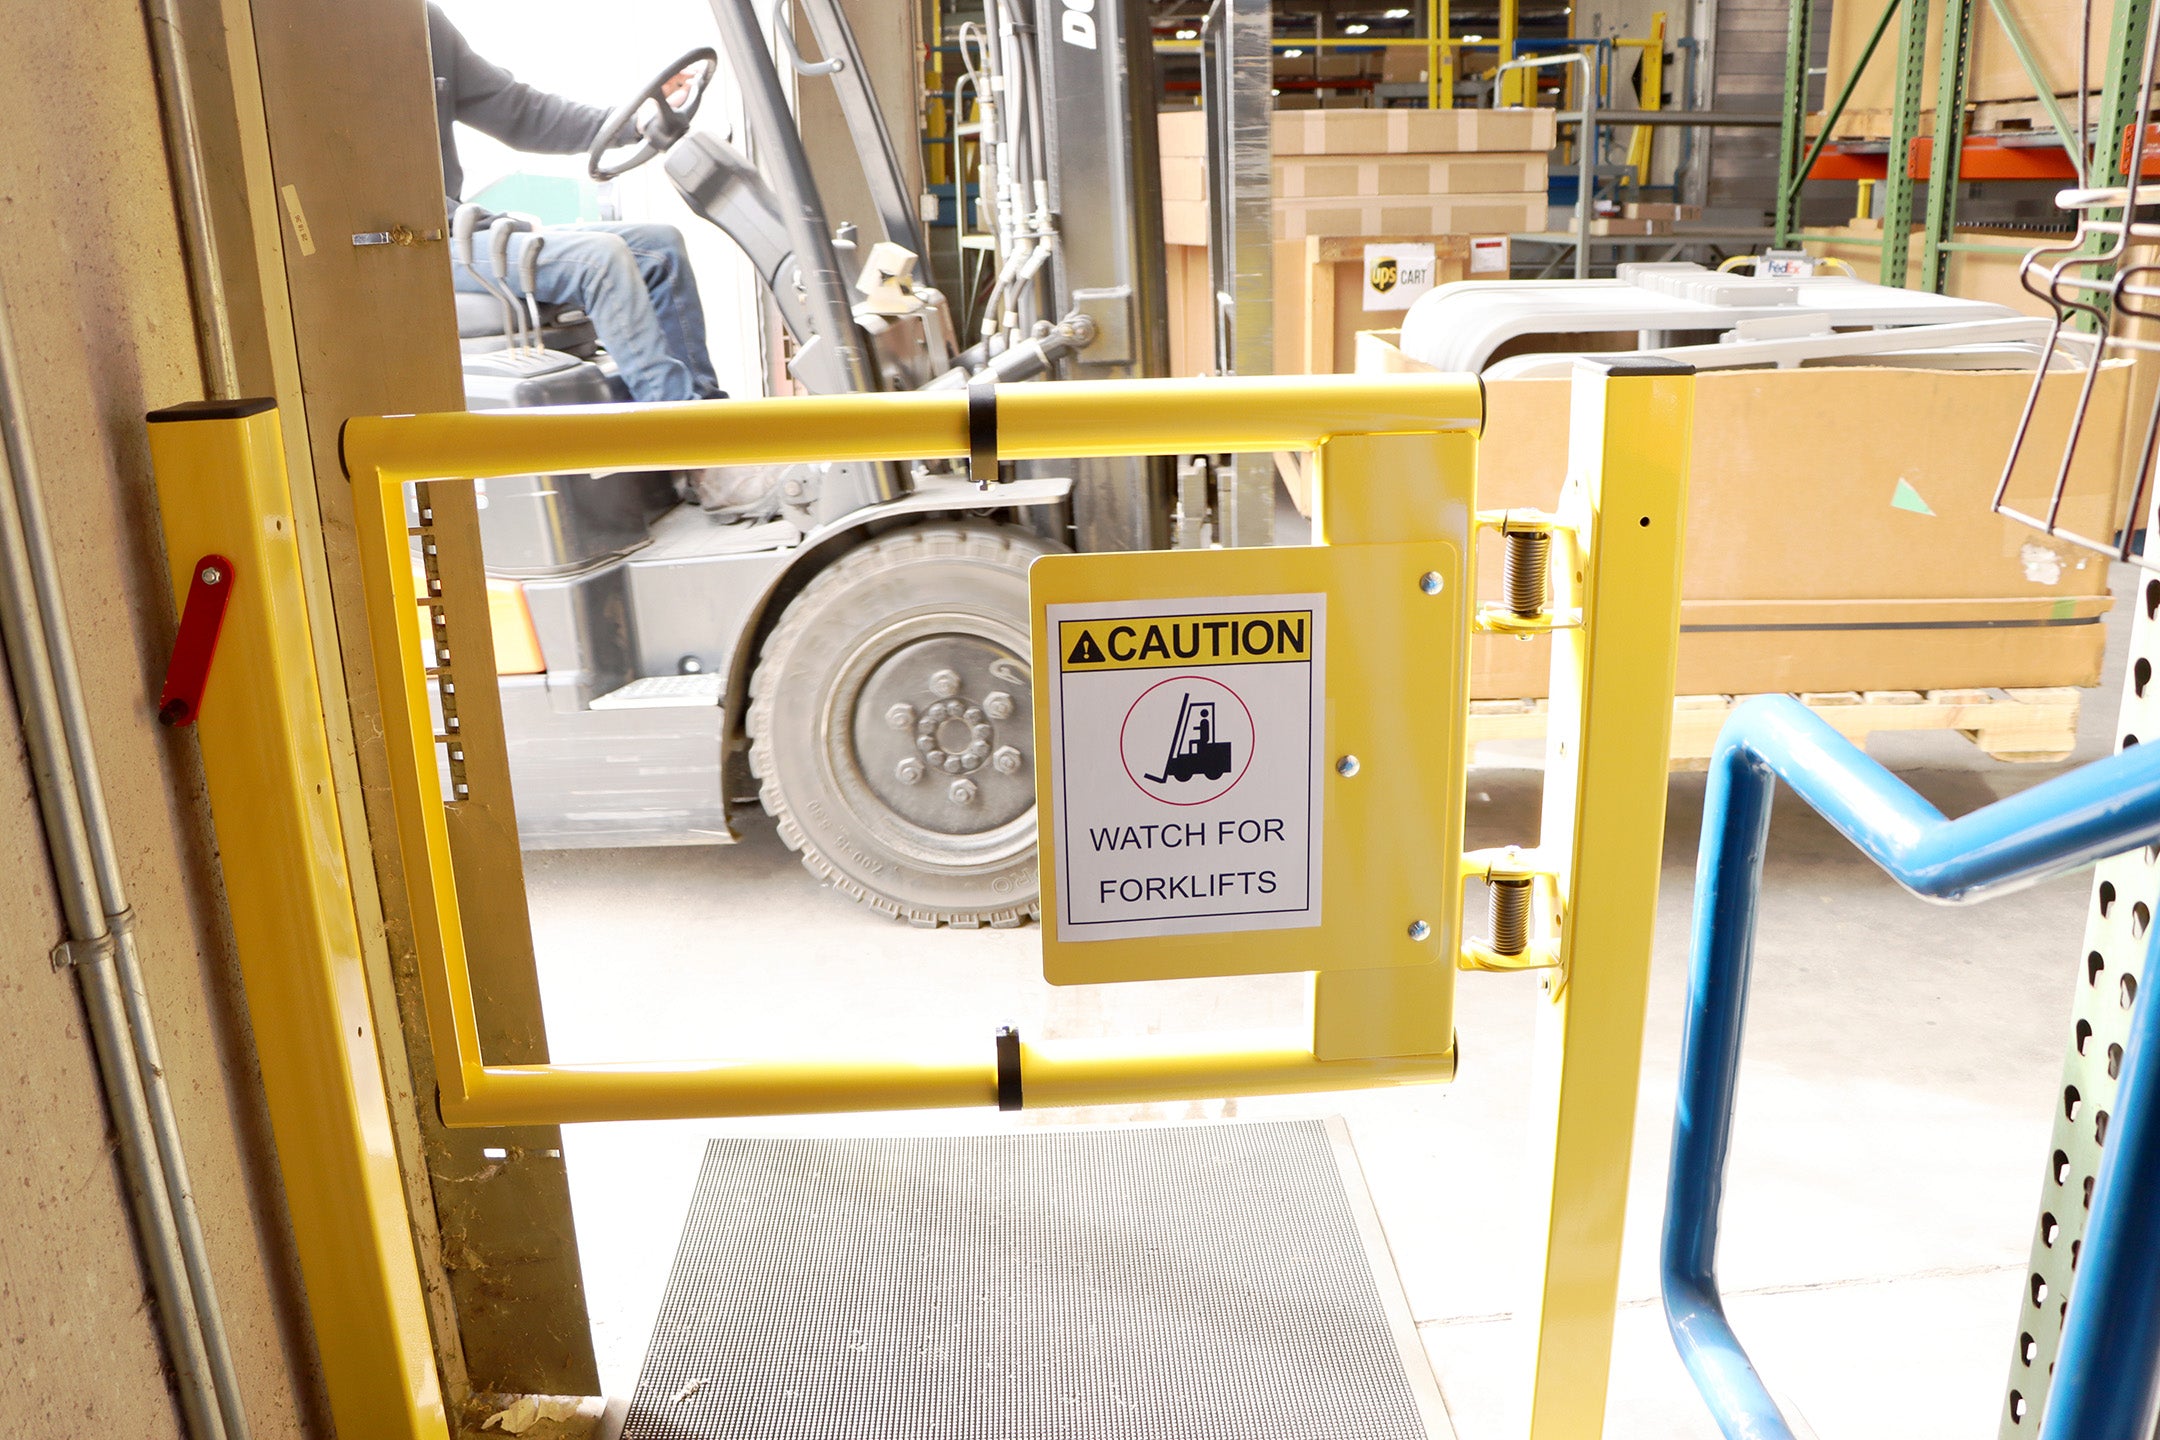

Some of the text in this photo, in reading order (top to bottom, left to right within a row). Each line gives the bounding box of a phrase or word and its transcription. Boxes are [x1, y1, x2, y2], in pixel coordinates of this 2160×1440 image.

[1372, 266, 1427, 290] ups CART
[1768, 260, 1800, 275] FedEx
[1107, 618, 1305, 662] CAUTION
[1089, 818, 1286, 852] WATCH FOR
[1100, 870, 1278, 904] FORKLIFTS
